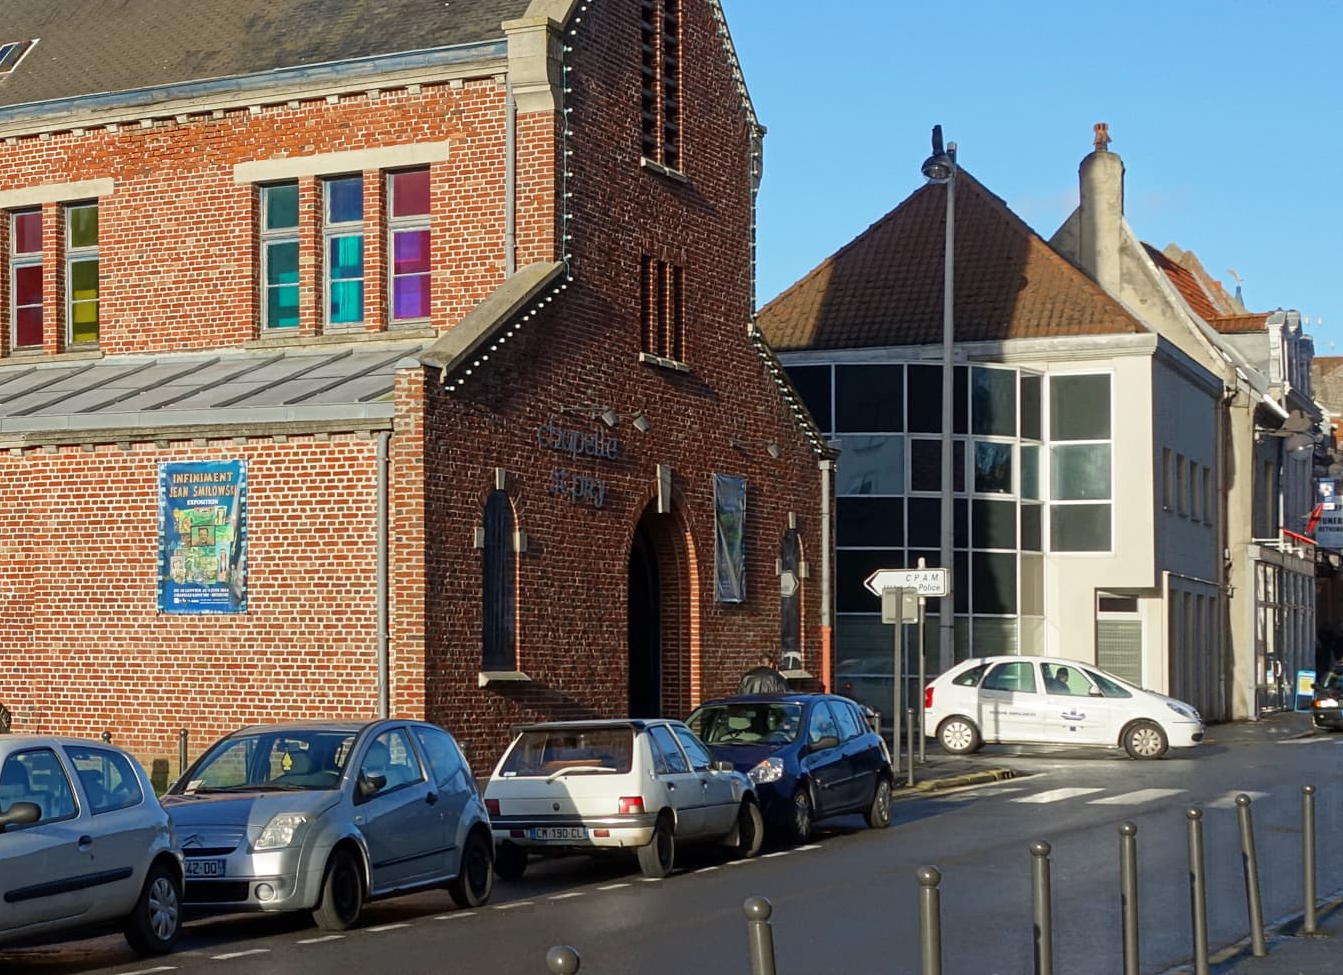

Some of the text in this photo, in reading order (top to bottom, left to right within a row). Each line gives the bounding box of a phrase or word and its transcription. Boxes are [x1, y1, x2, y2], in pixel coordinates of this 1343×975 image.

[173, 472, 233, 484] INFINIMENT
[169, 486, 189, 498] JEAN
[918, 583, 941, 592] Police
